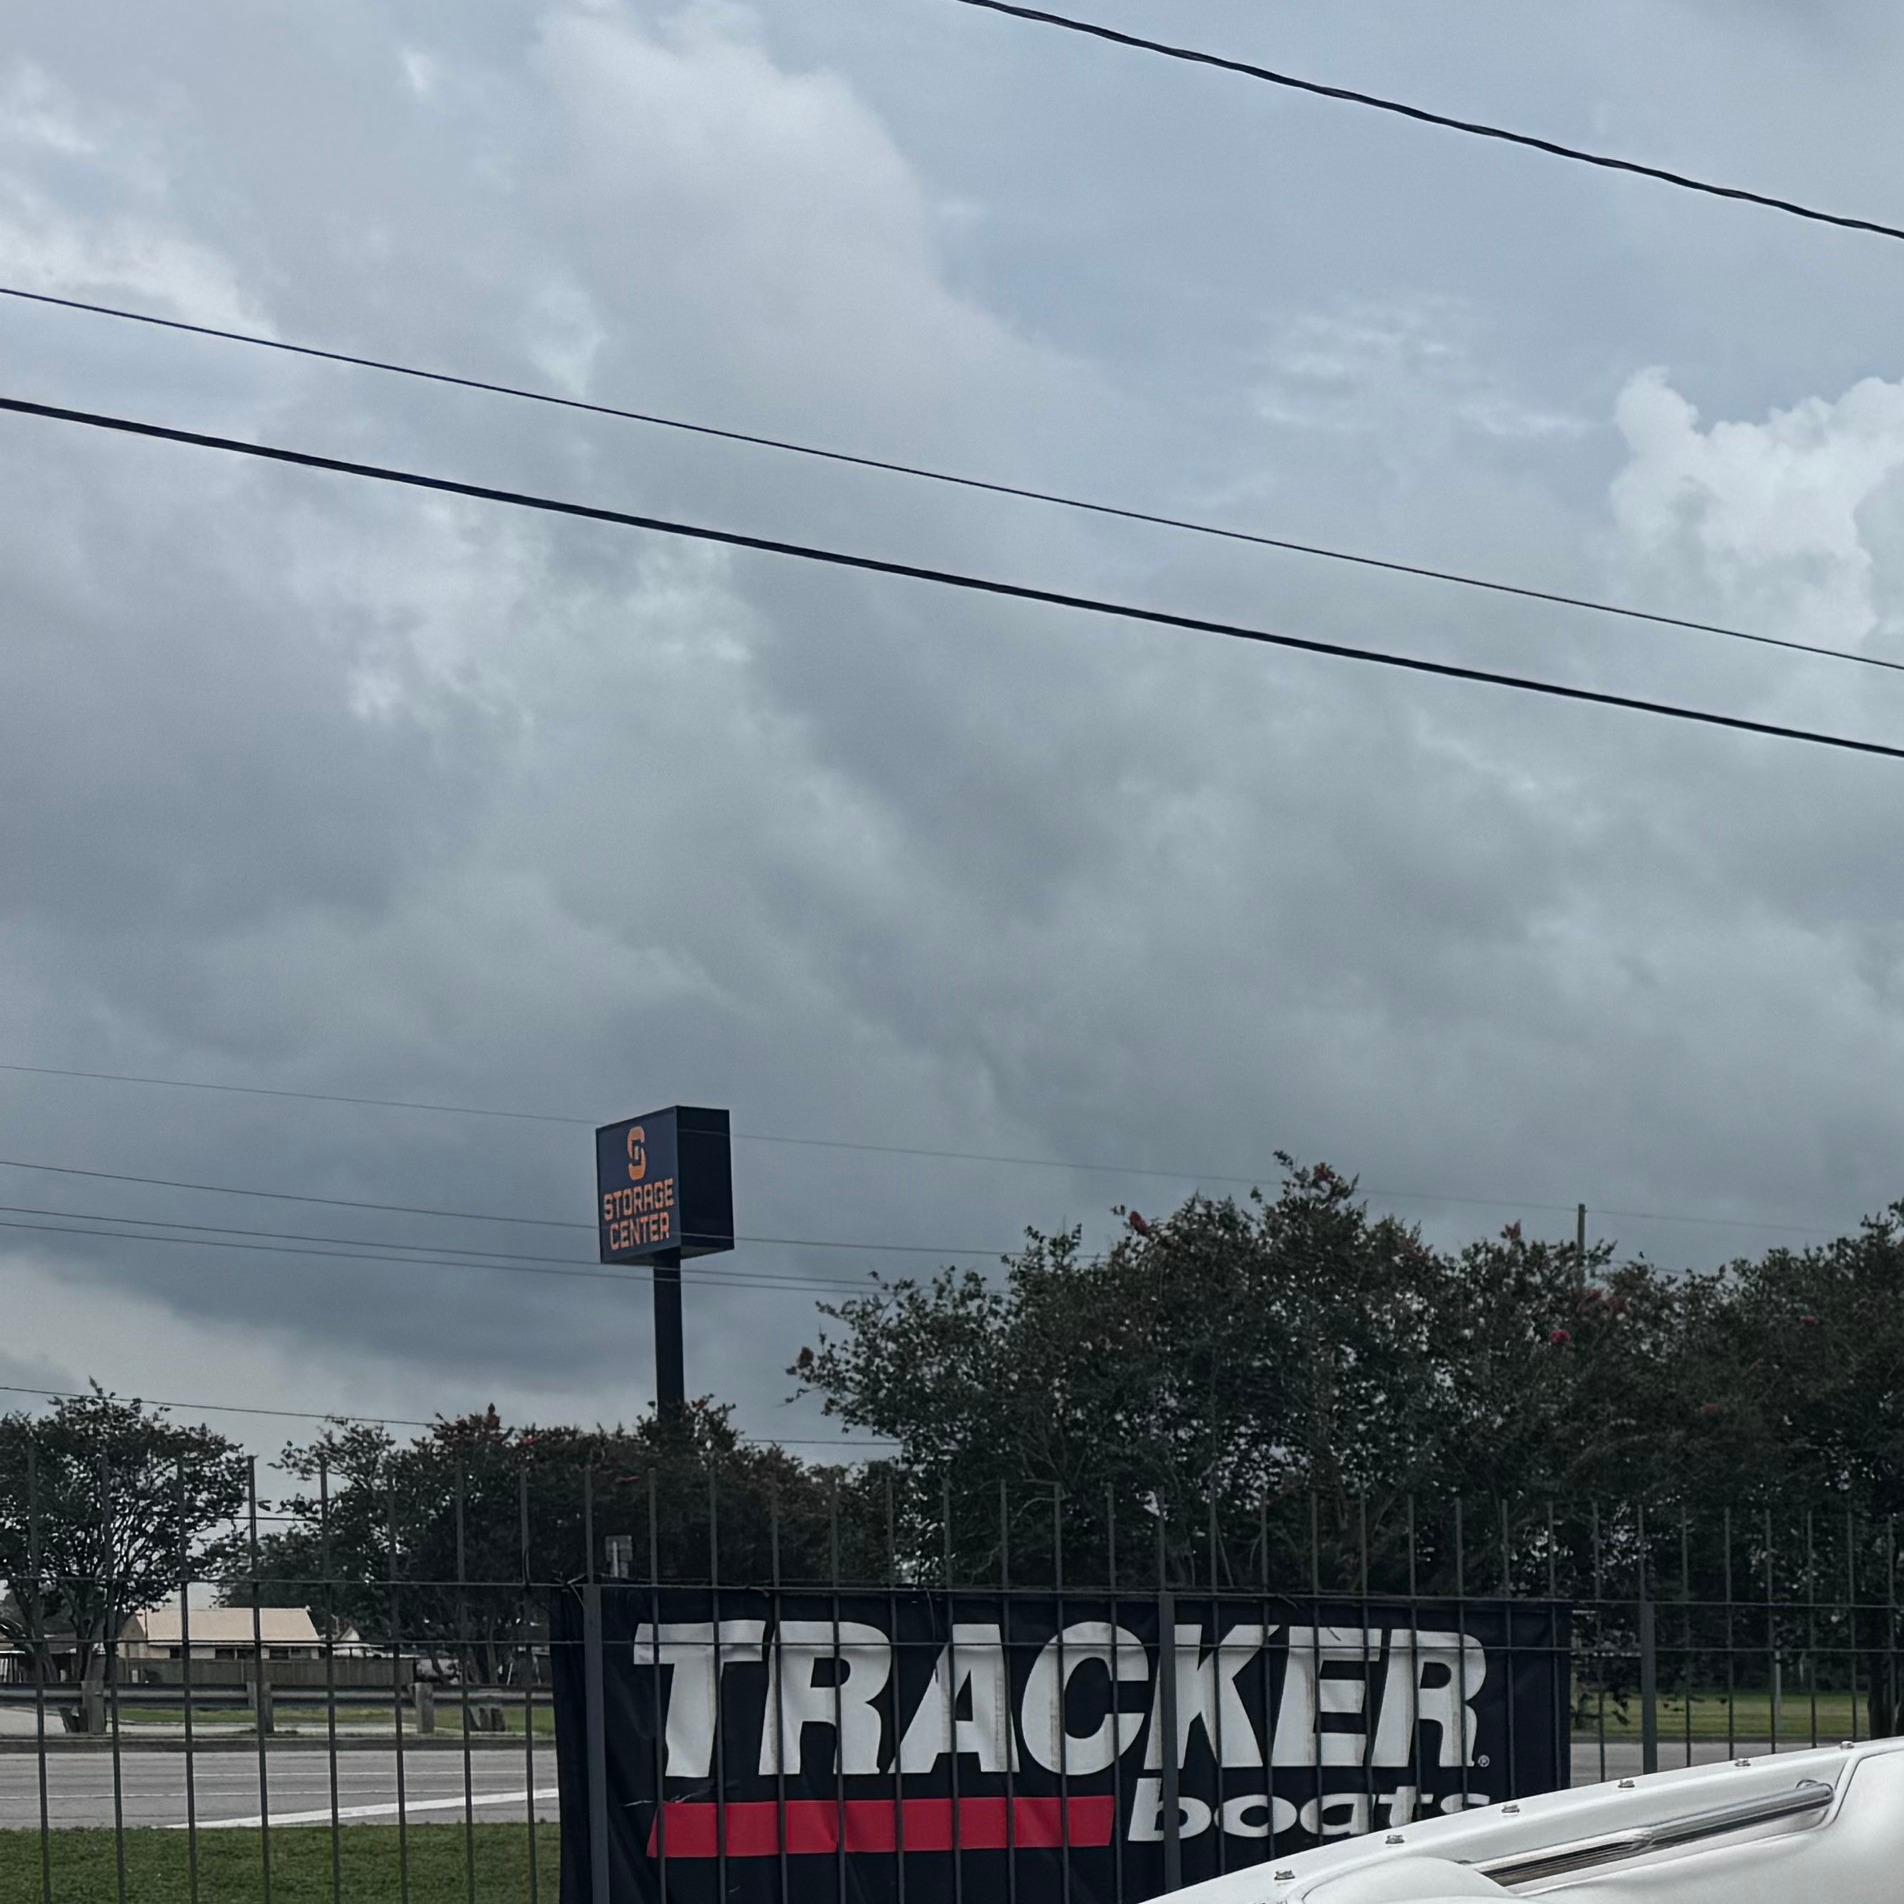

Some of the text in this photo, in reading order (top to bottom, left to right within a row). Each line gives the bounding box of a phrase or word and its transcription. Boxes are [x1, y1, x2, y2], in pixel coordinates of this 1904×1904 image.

[604, 1178, 674, 1221] STORAGE
[610, 1212, 670, 1250] CENTER
[633, 1618, 1488, 1777] TRACKER
